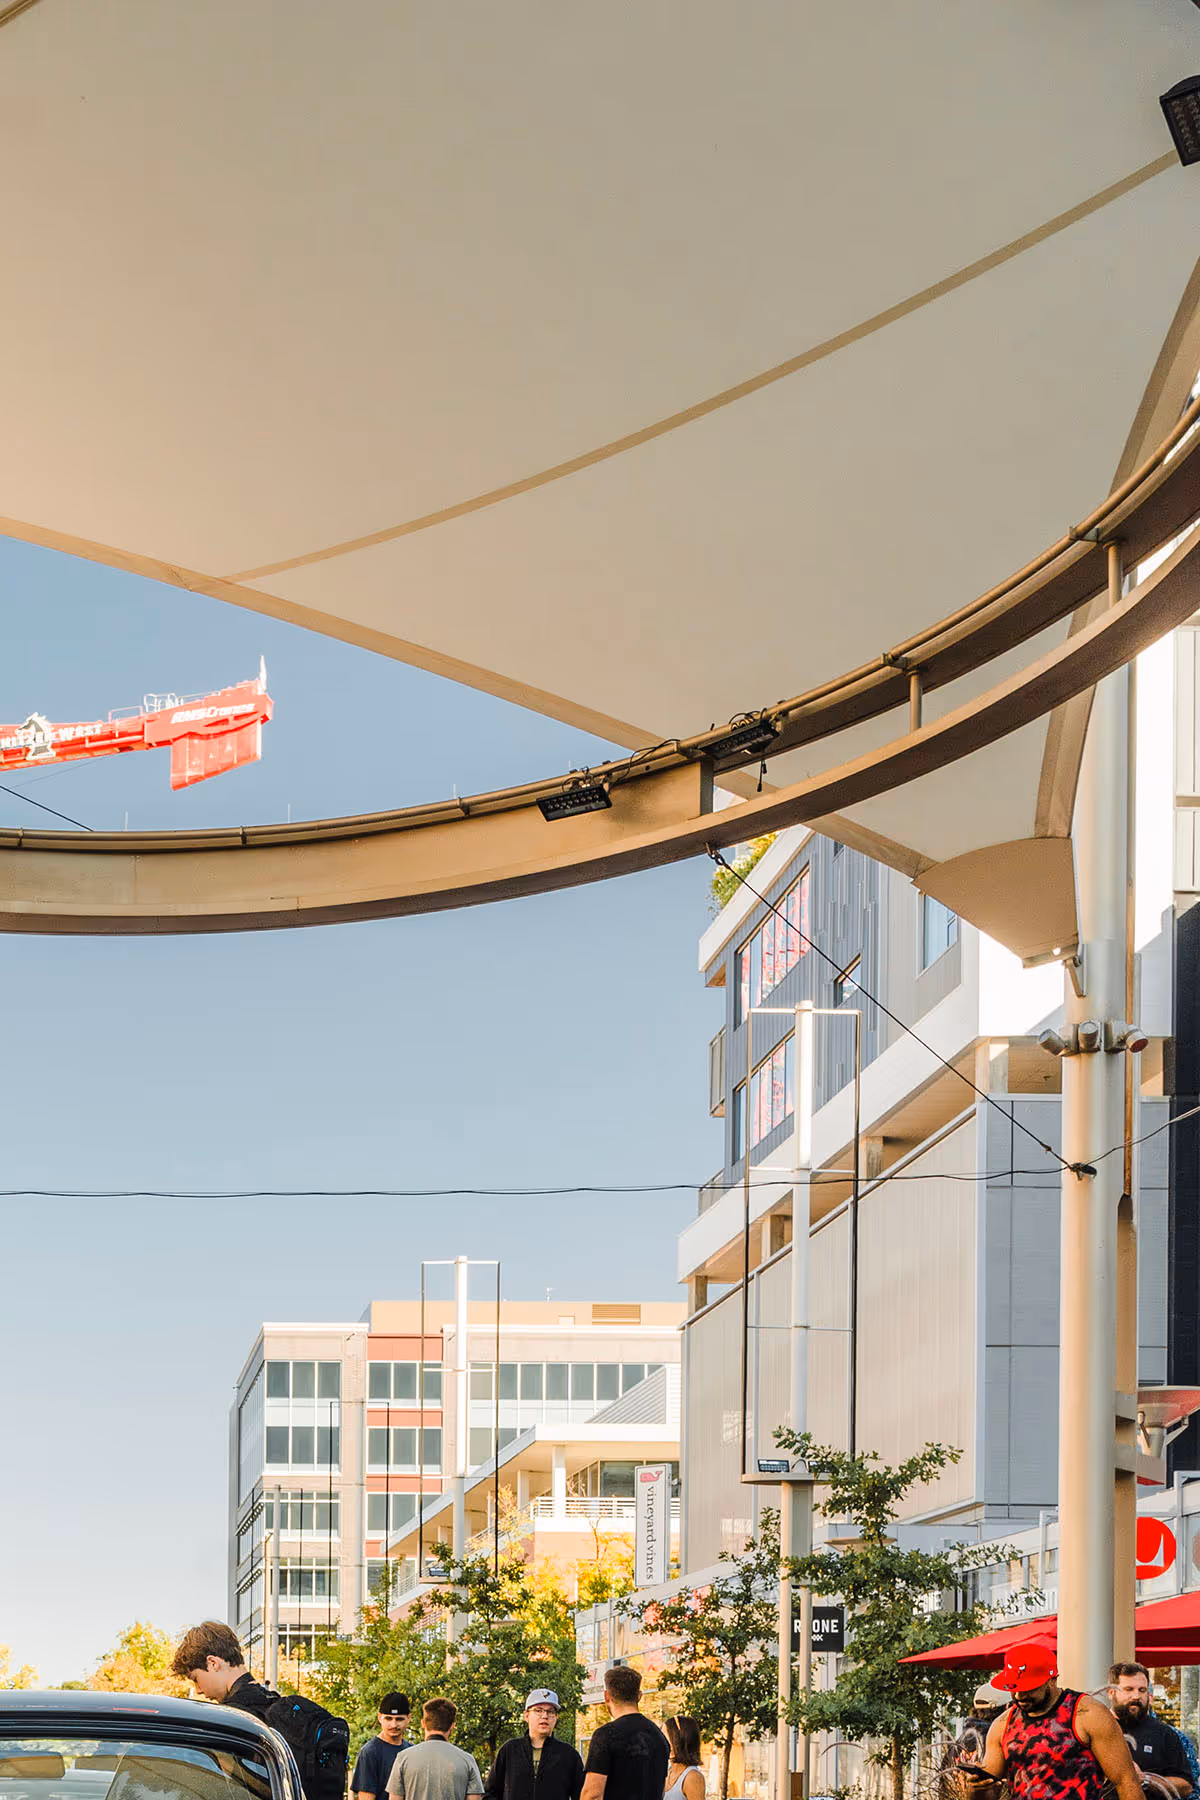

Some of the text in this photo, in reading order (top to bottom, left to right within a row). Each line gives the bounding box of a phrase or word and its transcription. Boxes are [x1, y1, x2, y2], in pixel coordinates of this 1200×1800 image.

[644, 1486, 657, 1580] vineyard vines
[793, 1618, 839, 1633] RONE
